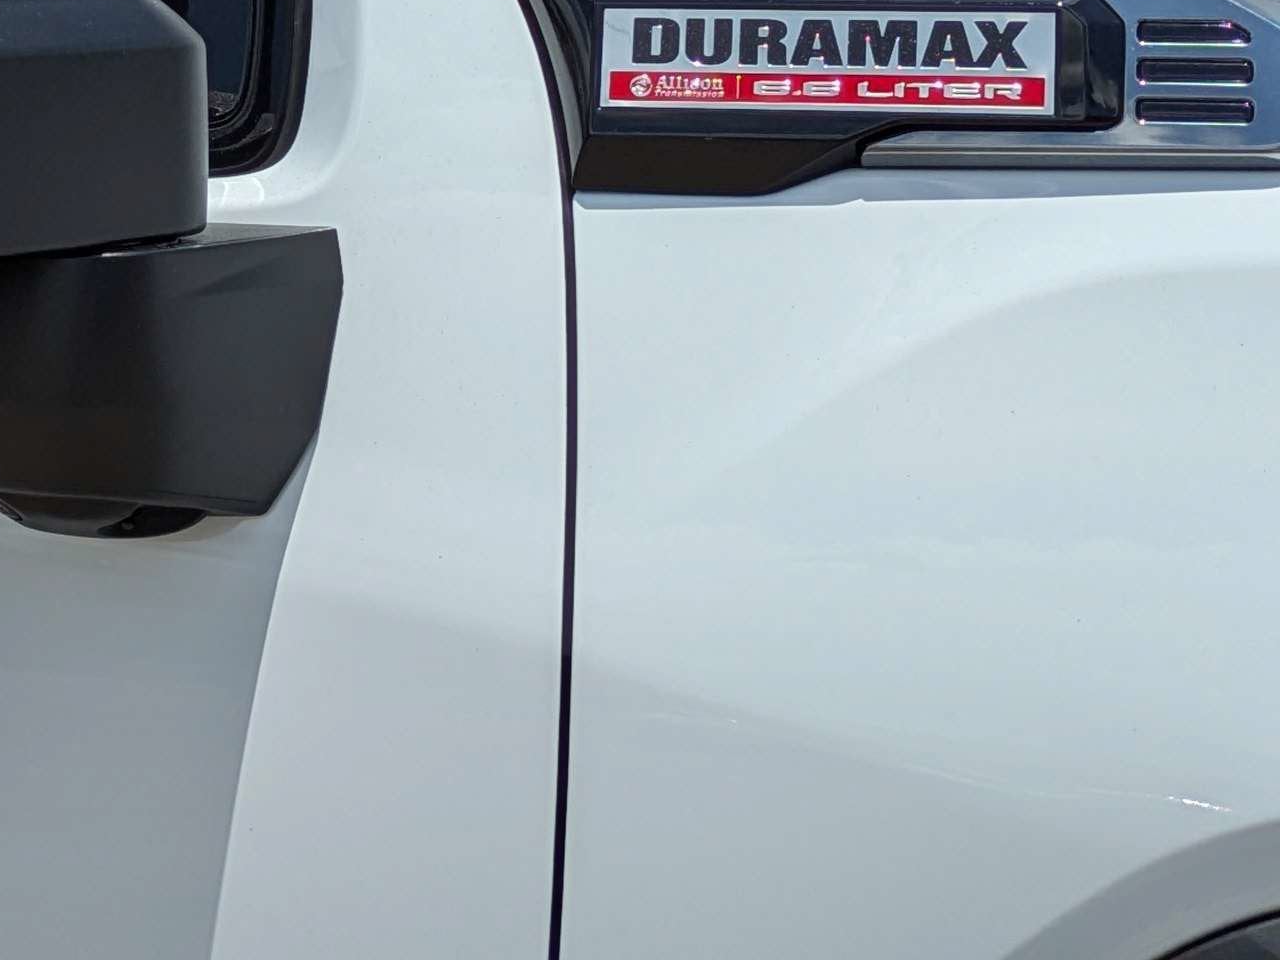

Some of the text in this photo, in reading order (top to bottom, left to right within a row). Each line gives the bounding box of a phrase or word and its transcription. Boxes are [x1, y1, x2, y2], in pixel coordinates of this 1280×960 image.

[631, 17, 1028, 70] DURAMAX
[655, 74, 724, 90] Allison
[752, 79, 1023, 100] 6.6 LITER
